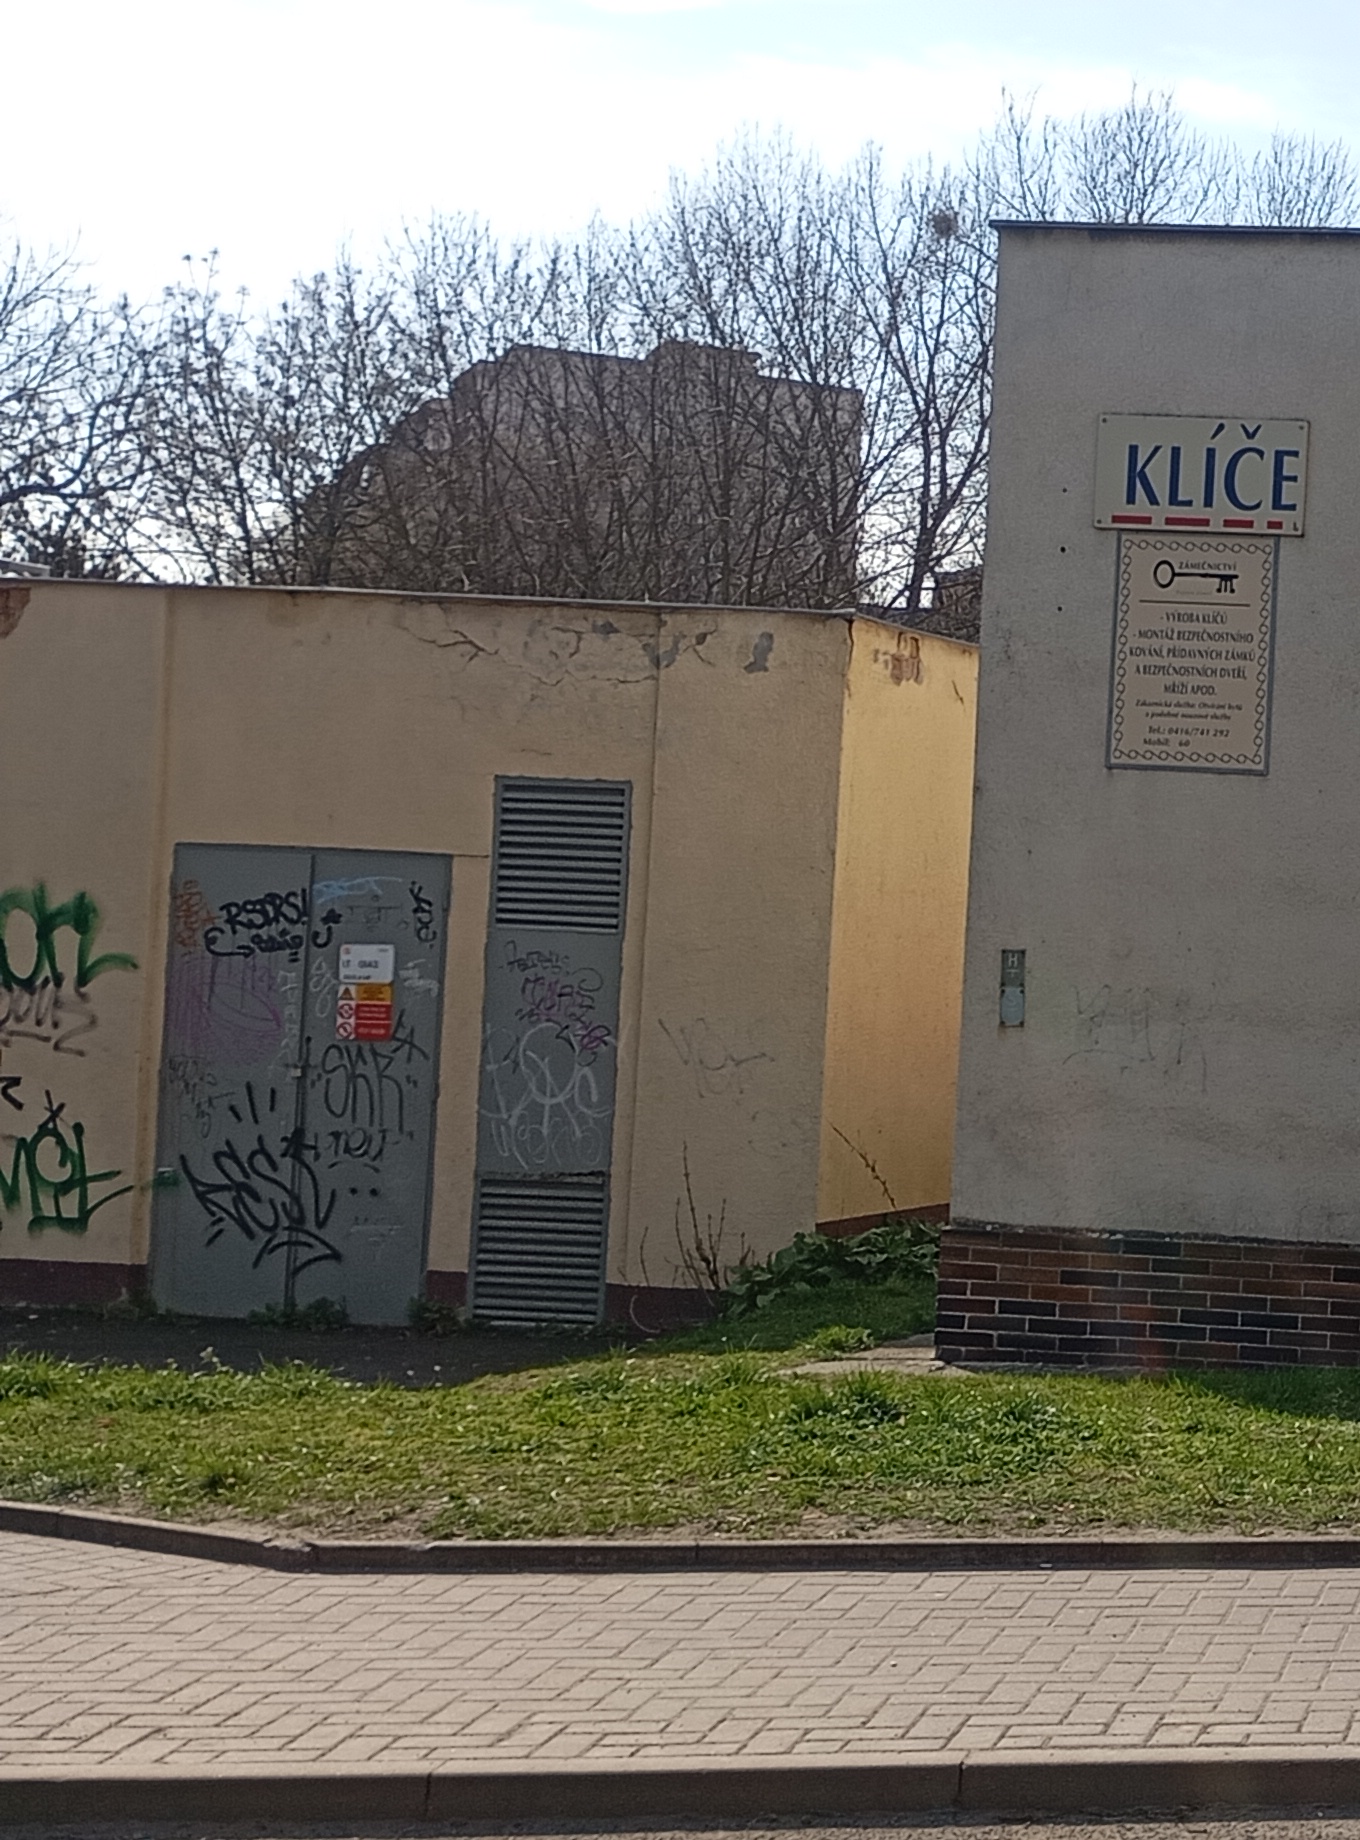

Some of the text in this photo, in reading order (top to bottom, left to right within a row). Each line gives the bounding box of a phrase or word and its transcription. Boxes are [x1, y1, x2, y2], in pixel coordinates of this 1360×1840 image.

[1126, 423, 1300, 511] KLÍČE
[1177, 561, 1238, 572] ZÁMEČNICTVÍ
[1165, 610, 1200, 624] VÝROBA
[1138, 627, 1175, 641] MONTÁŽ
[1176, 627, 1254, 643] BEZPEČNOSTNÍHO
[1167, 645, 1222, 661] PŘÍDAVNÝCH
[1224, 648, 1256, 662] ZÁMKŮ
[1135, 664, 1141, 675] A
[1142, 663, 1217, 678] BEZPEČNOSTNÍCH
[1190, 684, 1217, 696] APOD.
